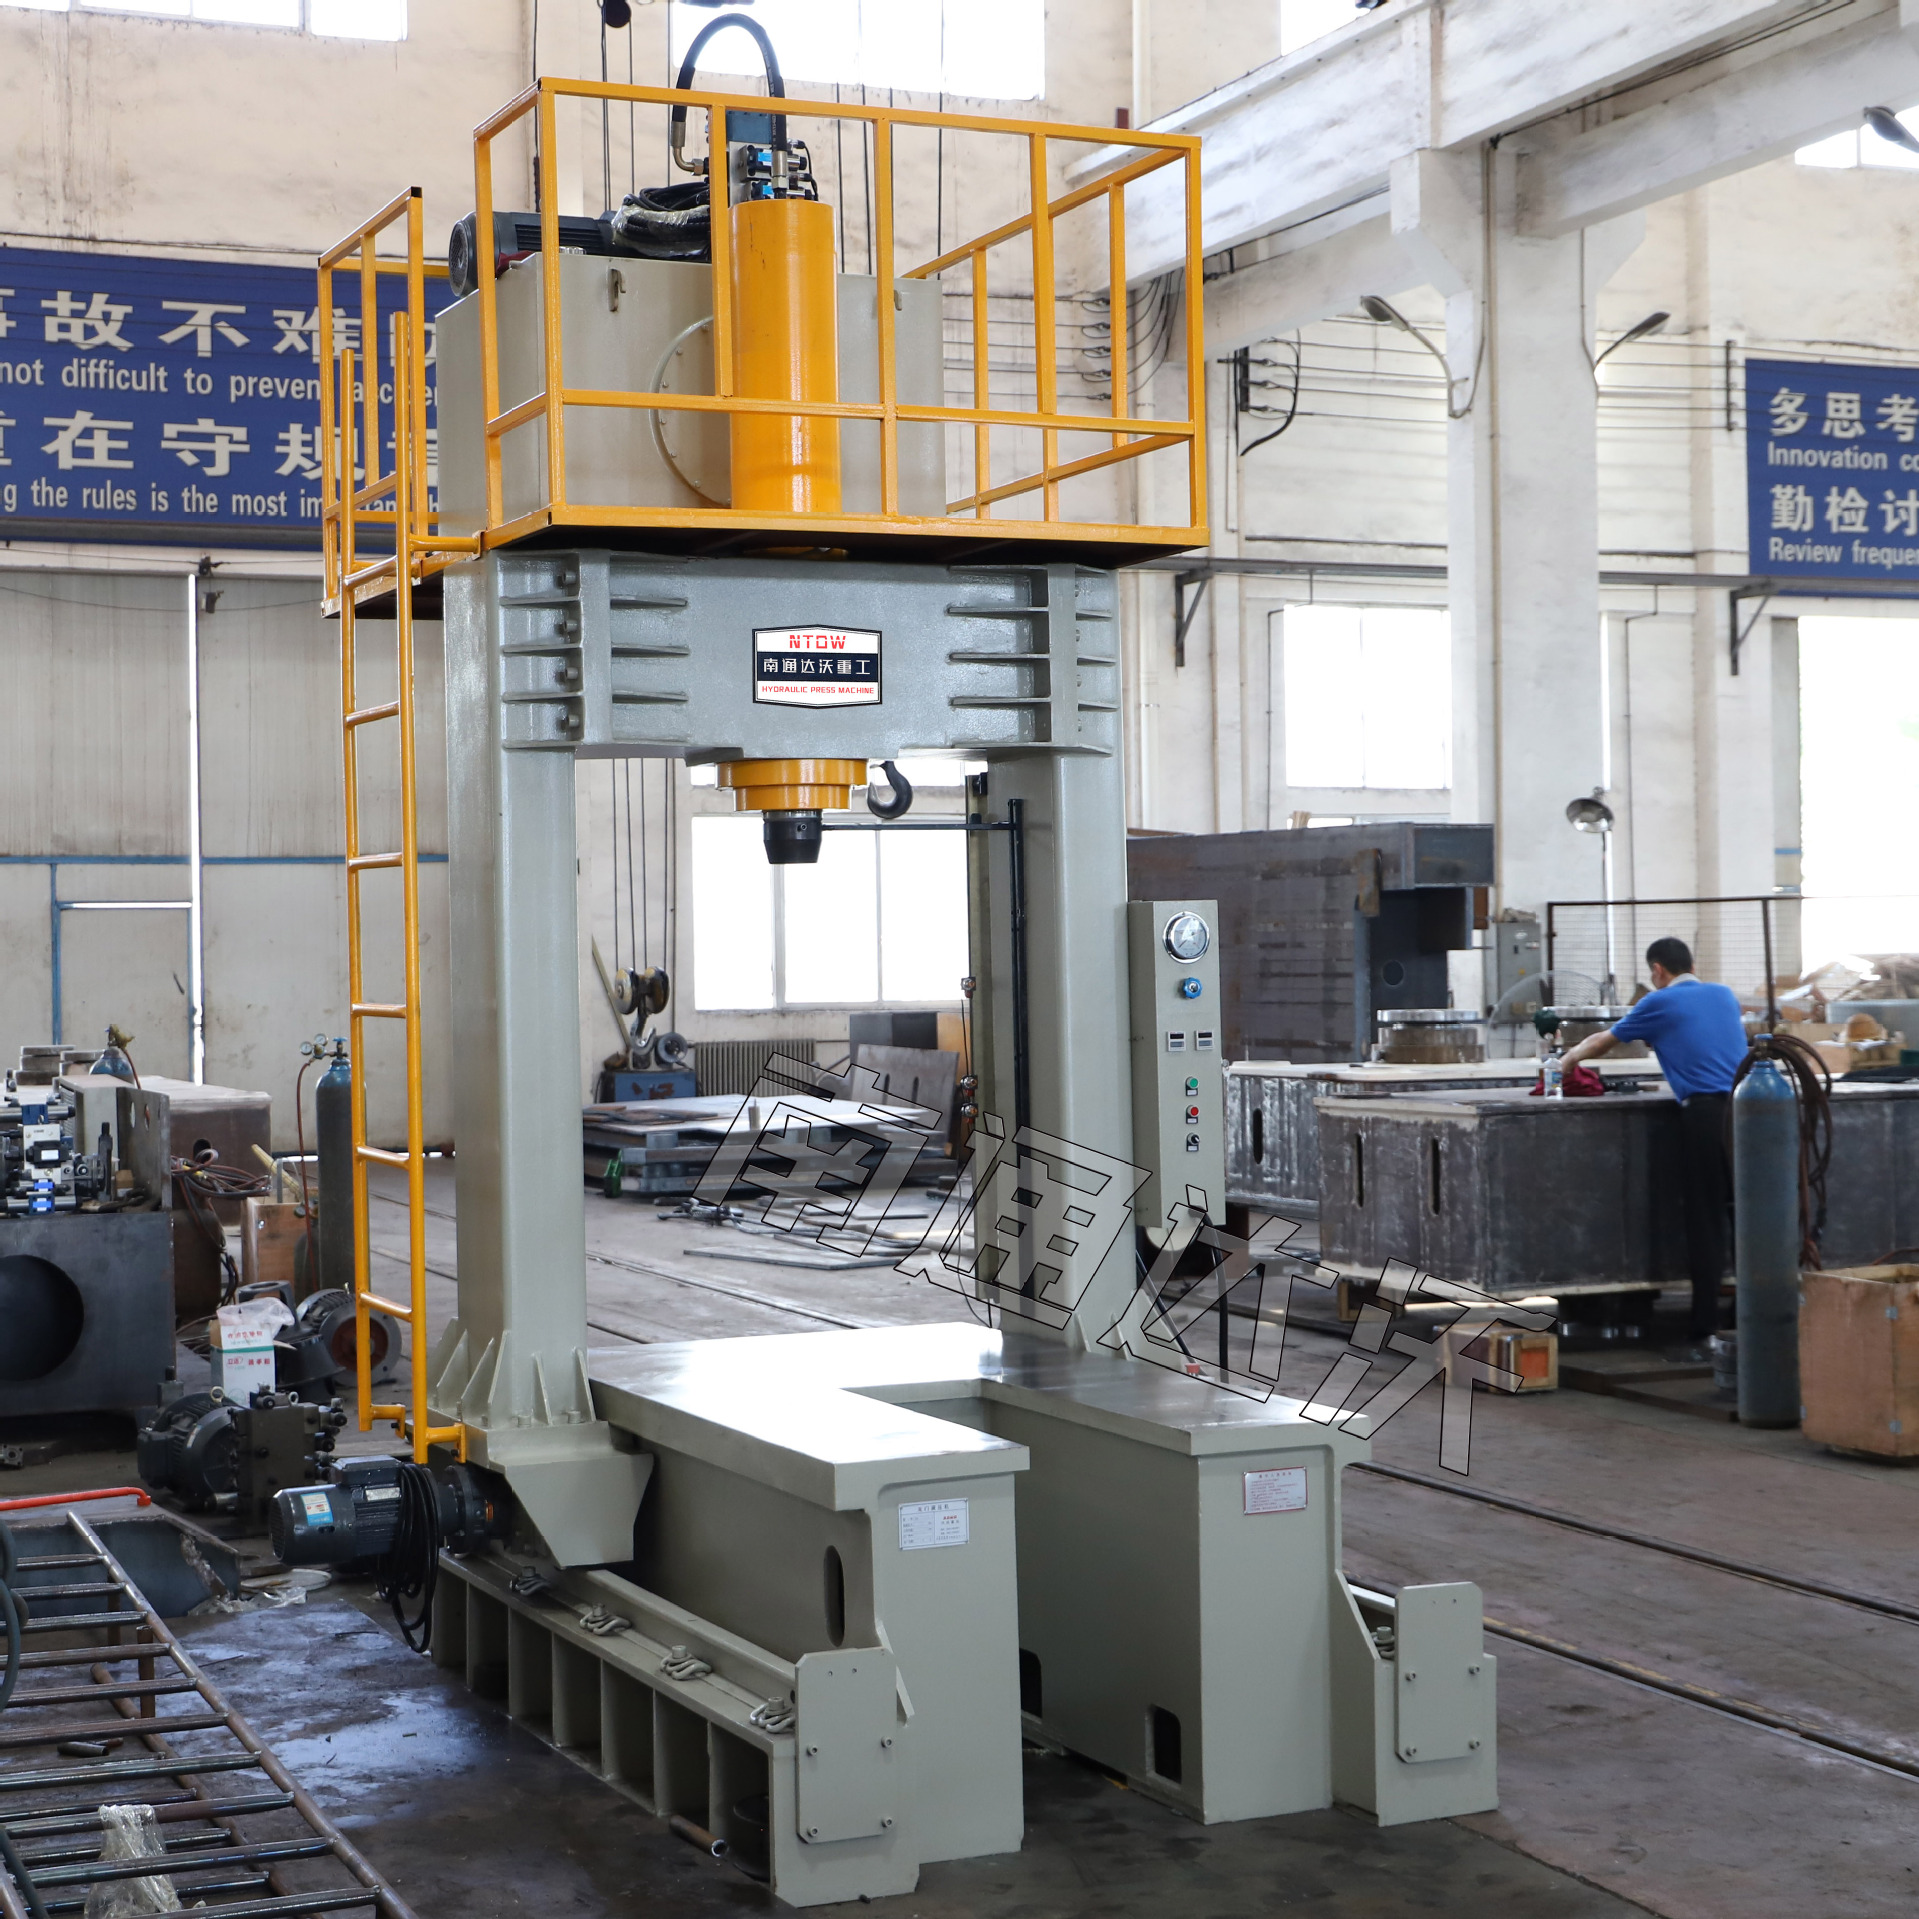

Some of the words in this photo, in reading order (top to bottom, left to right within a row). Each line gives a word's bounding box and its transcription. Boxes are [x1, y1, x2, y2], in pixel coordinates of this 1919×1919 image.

[0, 287, 436, 367] 故不难
[0, 359, 44, 386] not
[62, 357, 168, 393] difficult
[184, 367, 213, 395] to
[230, 374, 322, 403] preven
[1769, 387, 1919, 442] 多思考
[1768, 441, 1888, 470] Innovation
[31, 477, 69, 508] the
[83, 479, 137, 510] rules
[151, 482, 169, 511] is
[183, 484, 218, 514] the
[232, 491, 287, 517] most
[1769, 484, 1919, 536] 勤检讨
[1769, 537, 1843, 563] Review
[1852, 538, 1919, 570] freque
[763, 658, 871, 675] 南通达沃重工
[762, 685, 808, 693] HYDRAULIC
[810, 686, 836, 694] PRESS
